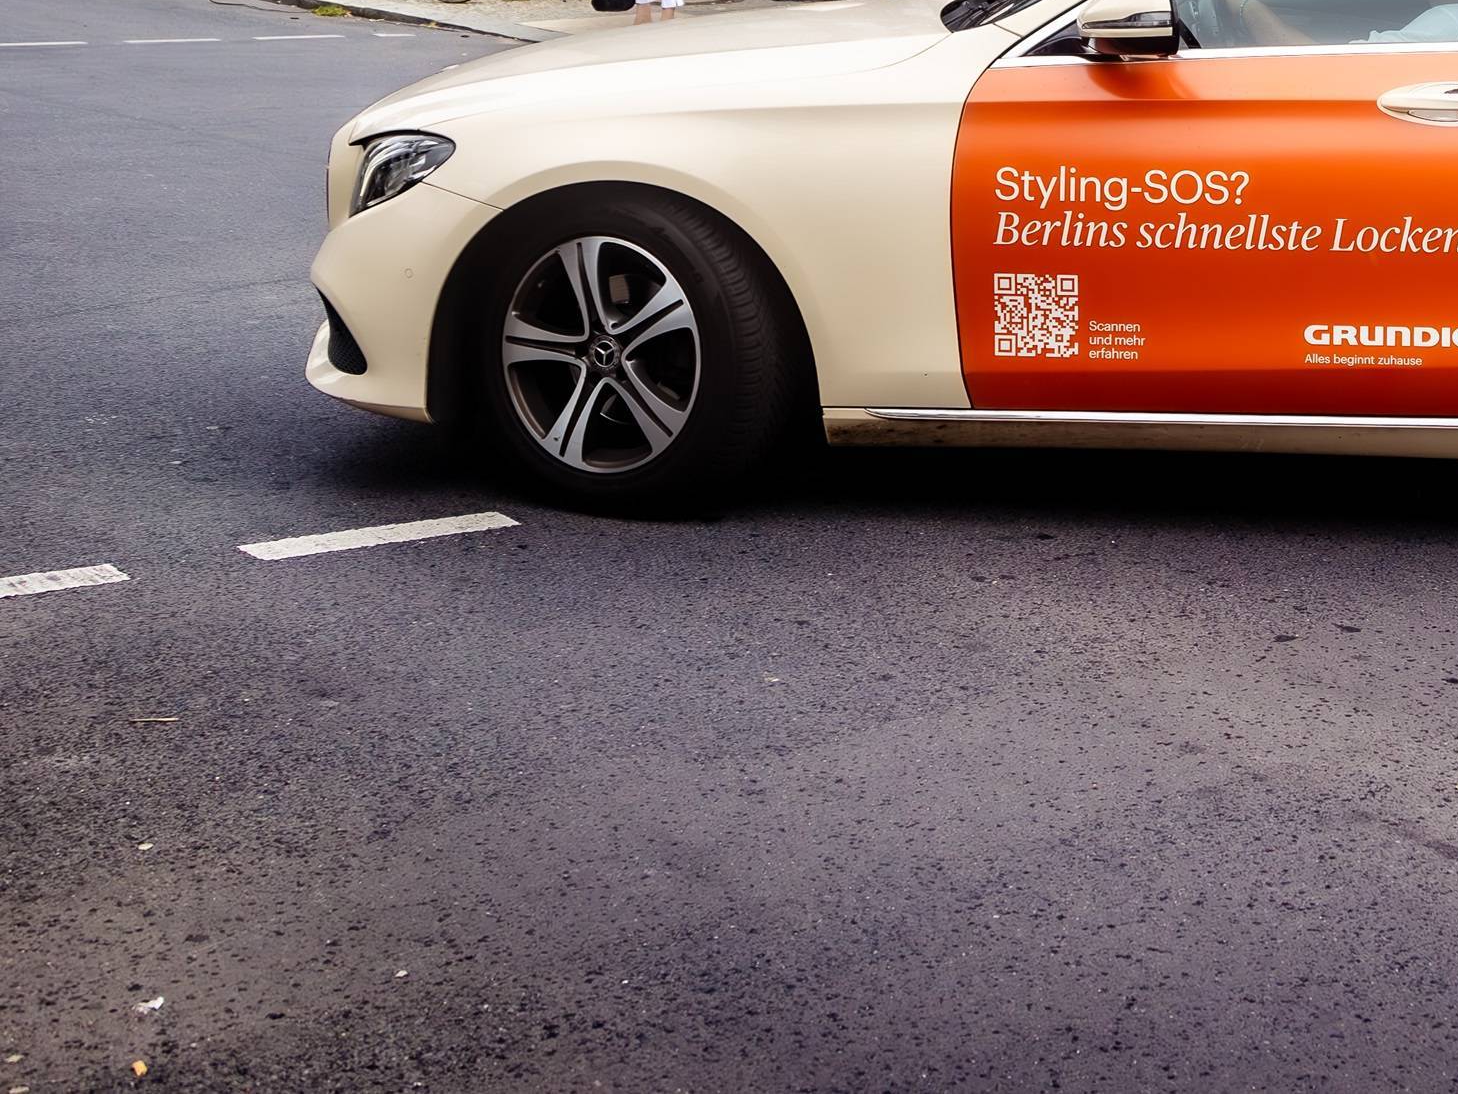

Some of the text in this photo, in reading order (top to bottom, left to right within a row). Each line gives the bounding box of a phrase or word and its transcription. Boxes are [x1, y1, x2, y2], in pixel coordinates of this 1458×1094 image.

[994, 166, 1250, 211] Styling-SOS?
[993, 212, 1128, 248] Berlins
[1136, 213, 1322, 252] schnellste
[1089, 320, 1141, 332] Scannen
[1089, 334, 1146, 346] und mehr
[1089, 347, 1138, 359] erfahren
[1304, 354, 1423, 367] Alles beginnt zuhause
